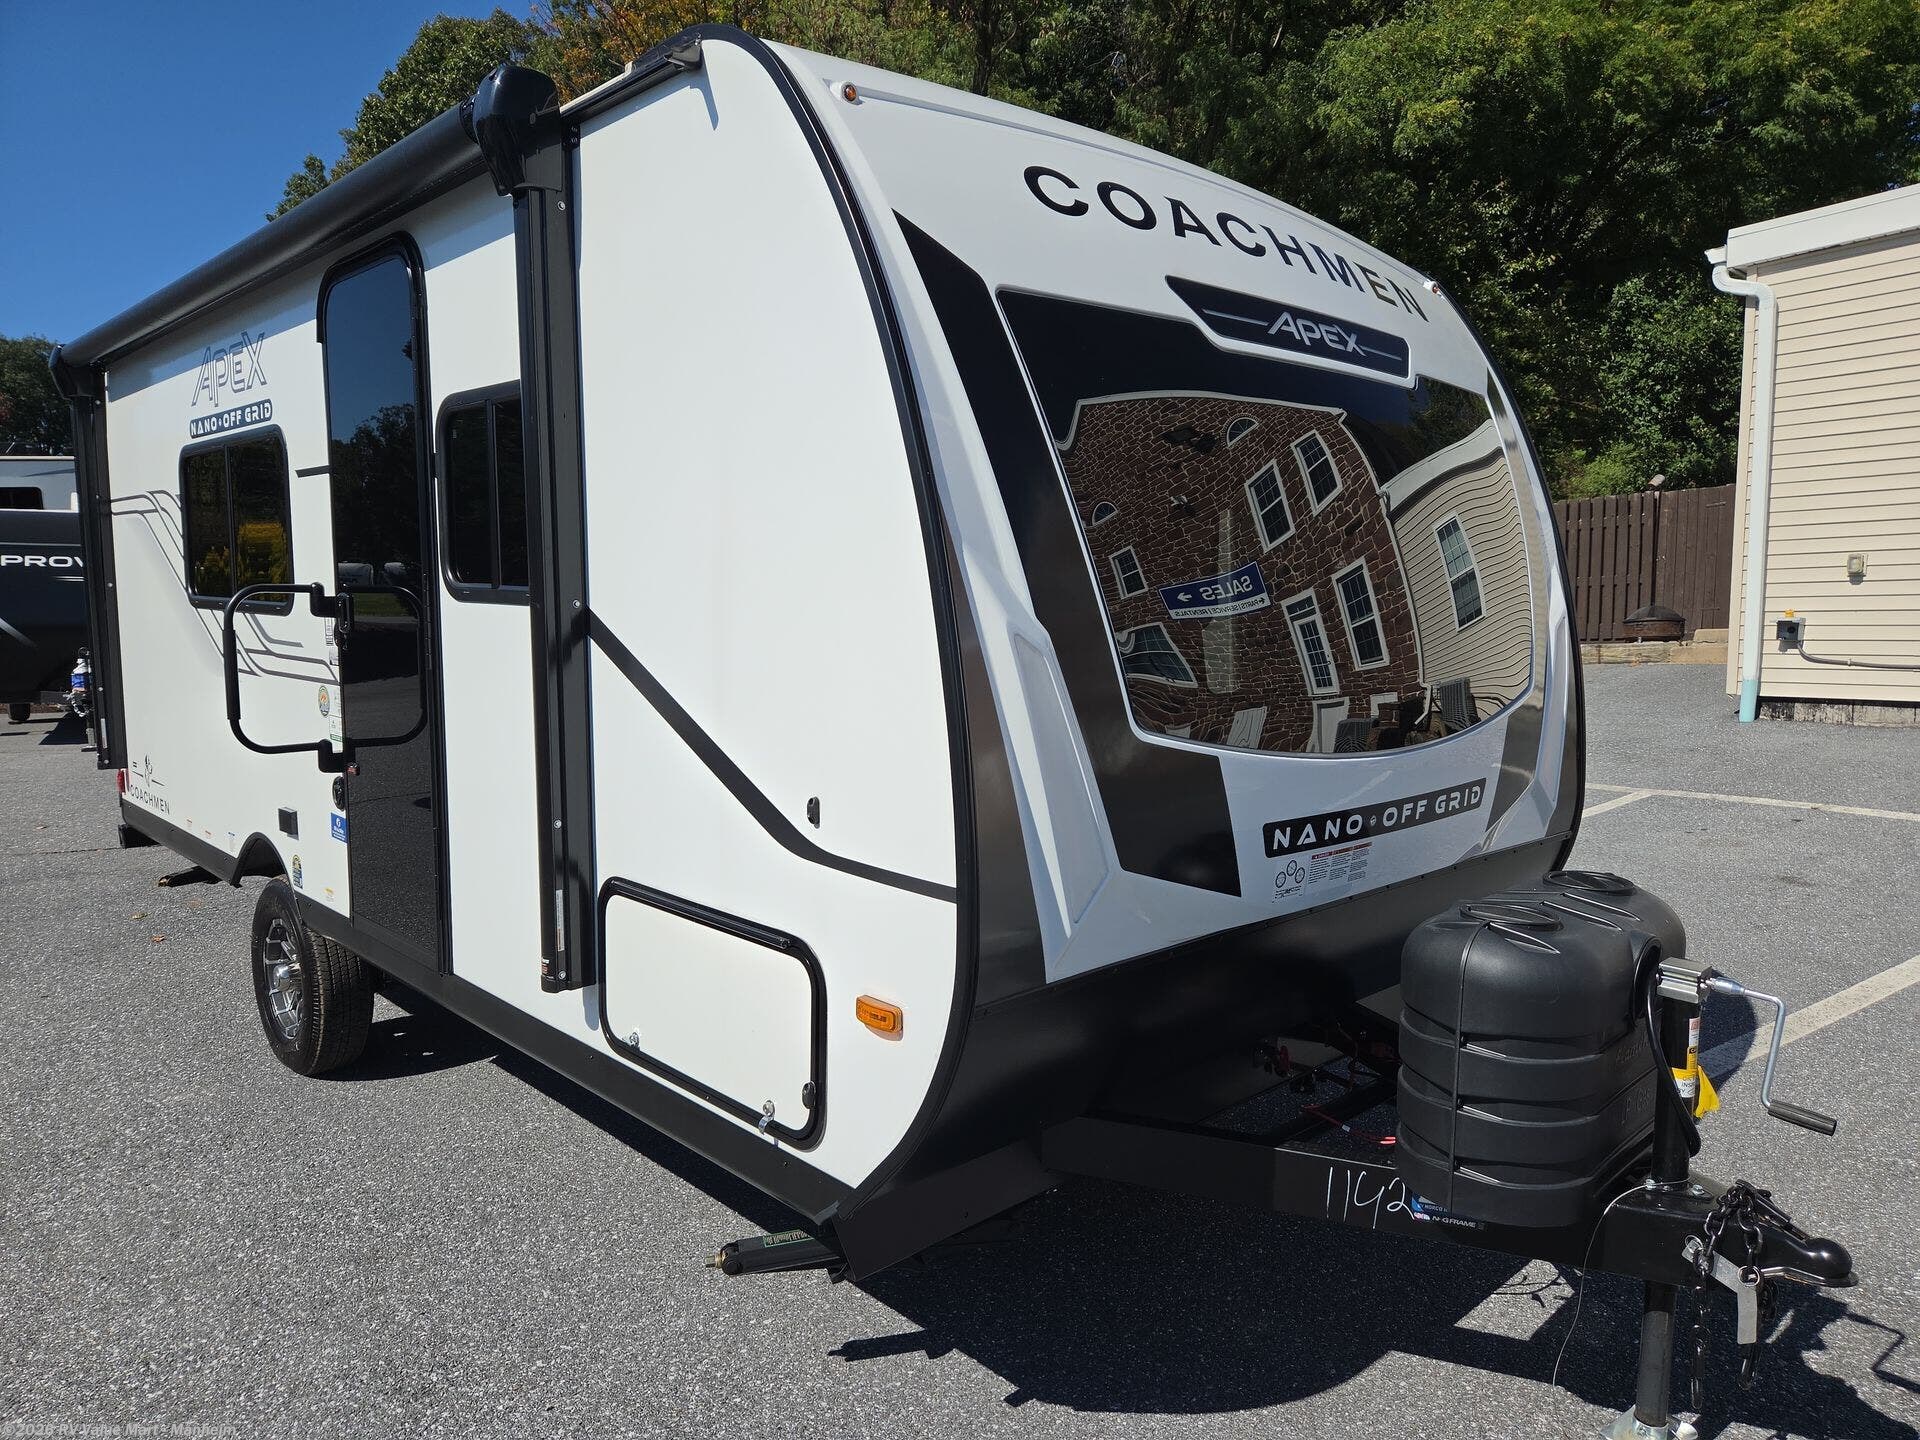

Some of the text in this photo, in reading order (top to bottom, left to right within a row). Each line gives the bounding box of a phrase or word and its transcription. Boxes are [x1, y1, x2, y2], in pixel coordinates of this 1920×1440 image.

[1023, 165, 1430, 323] COACHMEN
[1267, 311, 1367, 357] APEX
[191, 330, 267, 407] APEX
[190, 402, 272, 436] NANO OFF GRID
[130, 784, 170, 815] COACHMEN
[1273, 785, 1481, 850] NANO OFF GRID
[1326, 1166, 1415, 1230] 1142
